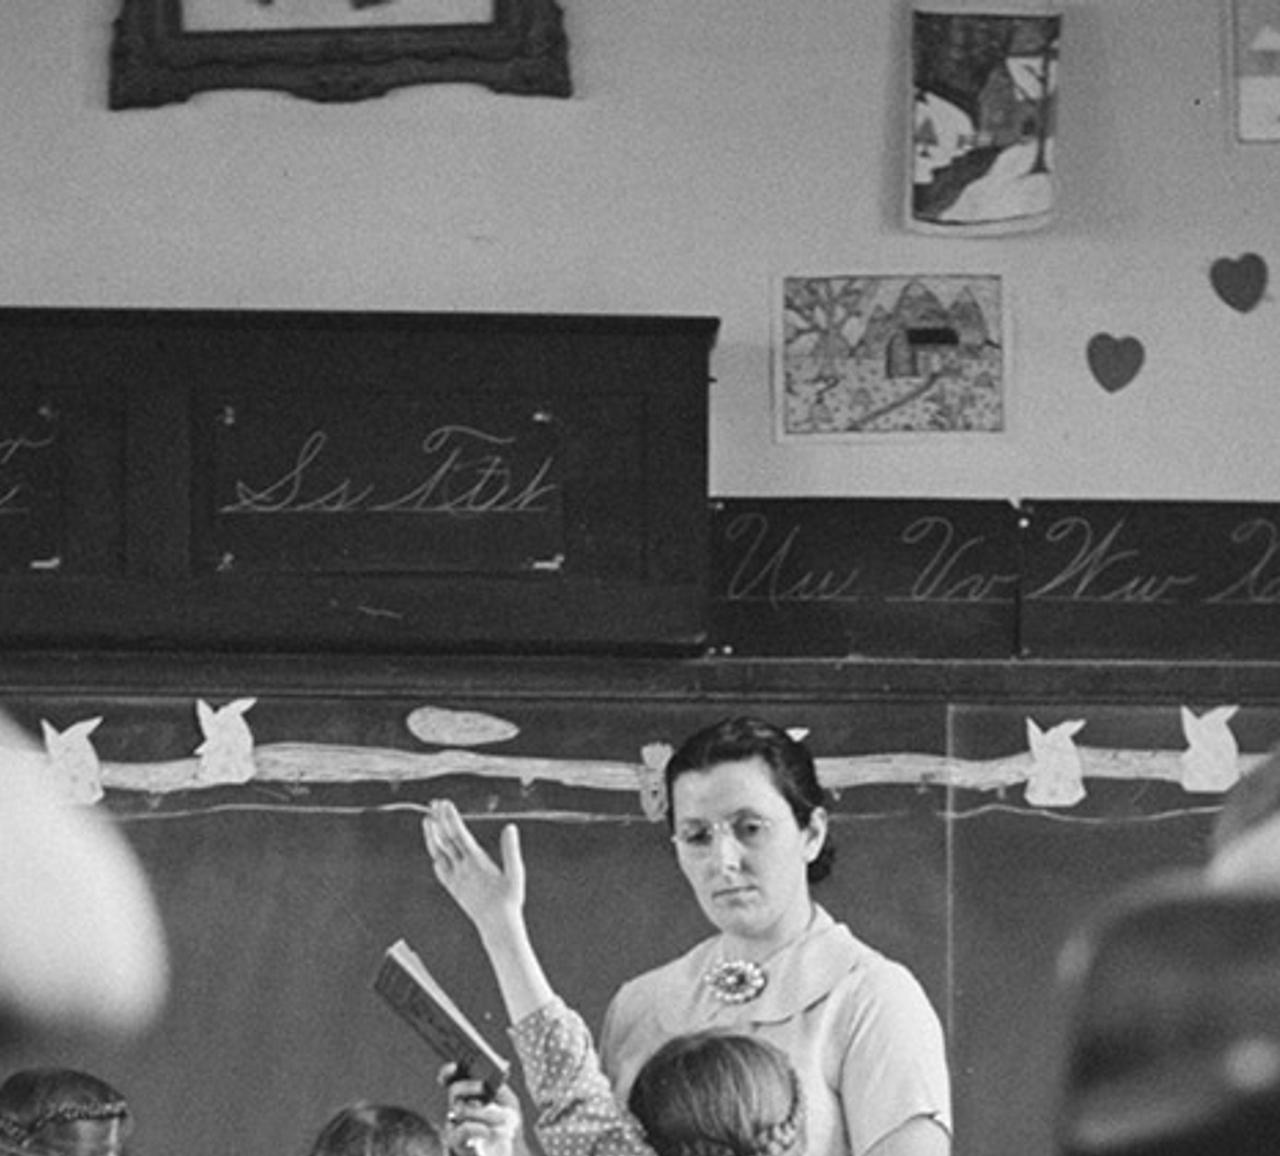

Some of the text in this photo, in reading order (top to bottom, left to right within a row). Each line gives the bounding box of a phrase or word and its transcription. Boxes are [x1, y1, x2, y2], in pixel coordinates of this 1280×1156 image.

[221, 430, 375, 512] Ss
[725, 512, 1019, 610] Uu Vv
[1023, 516, 1198, 602] Ww
